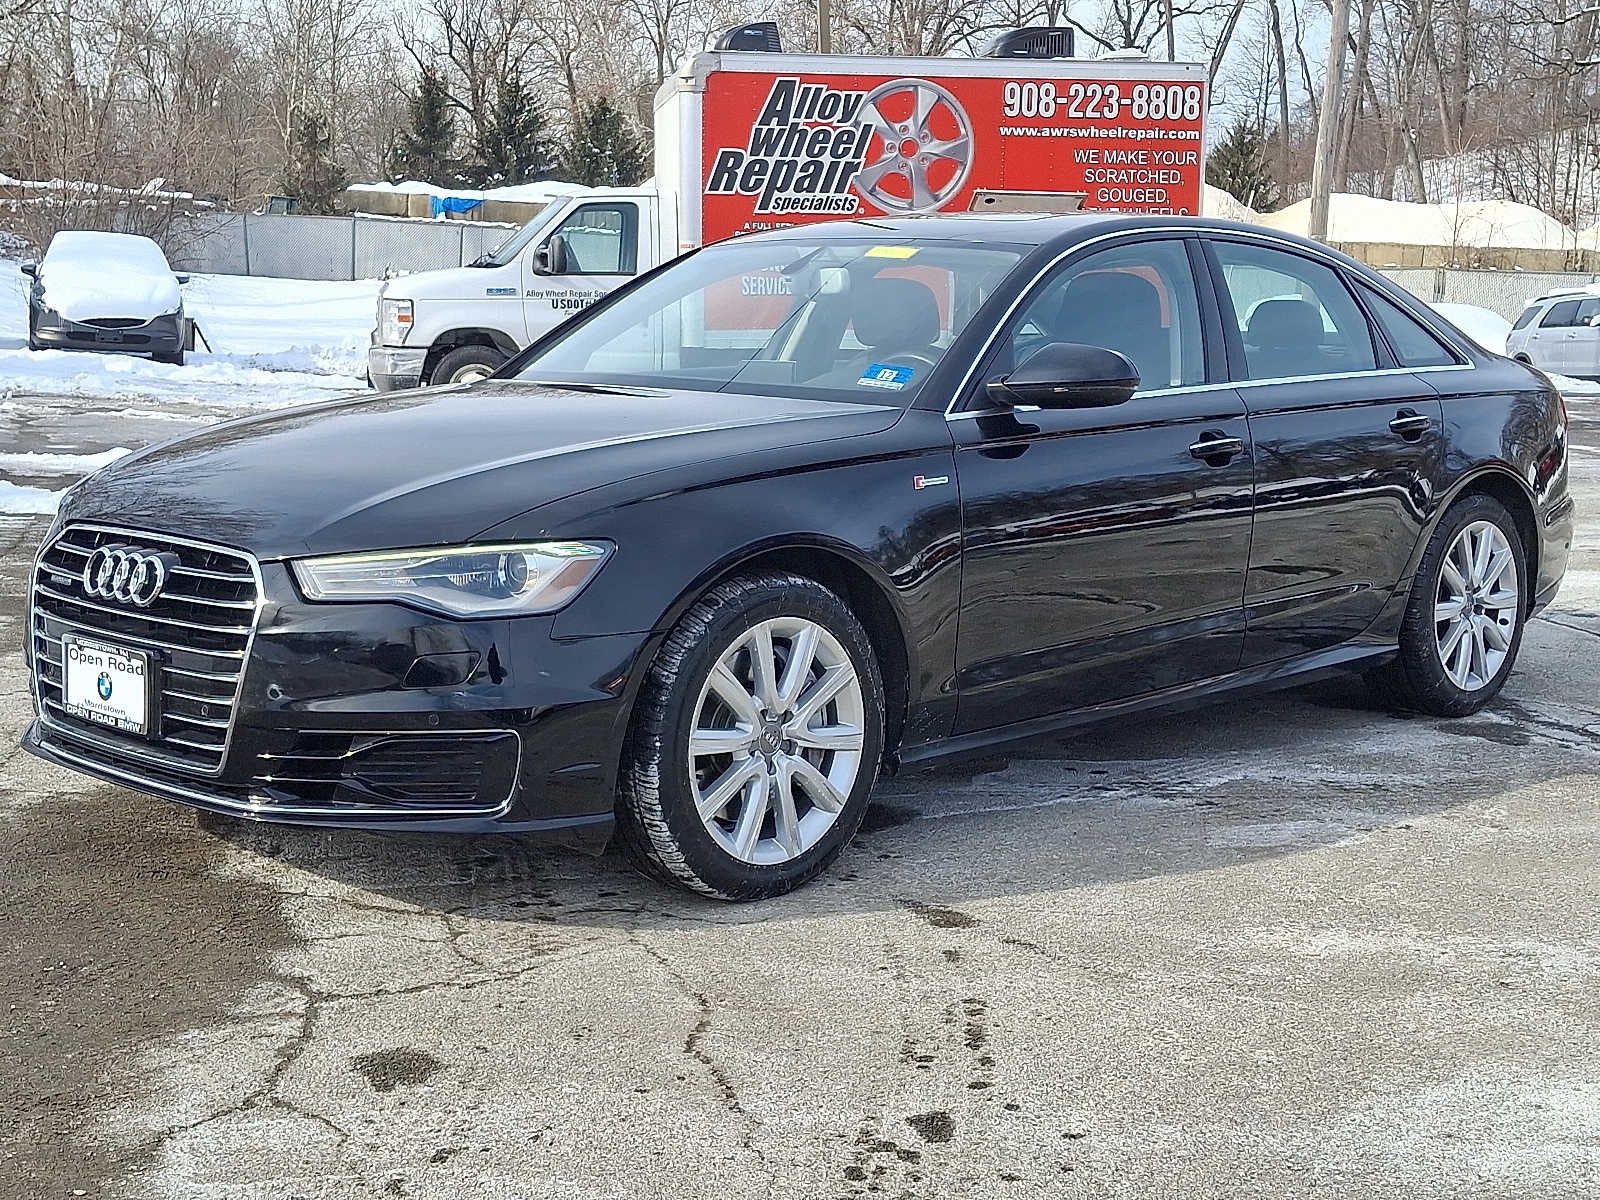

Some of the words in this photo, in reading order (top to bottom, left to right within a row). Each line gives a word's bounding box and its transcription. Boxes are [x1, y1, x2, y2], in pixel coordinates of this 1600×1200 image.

[756, 77, 868, 126] Alloy
[1003, 81, 1201, 120] 908-223-8808
[748, 122, 874, 160] wheel
[1000, 126, 1200, 141] www.awrswheelrepair.com
[1073, 149, 1100, 164] WE
[1103, 150, 1148, 165] MAKE
[1152, 151, 1198, 165] YOUR
[706, 148, 864, 213] Repair
[1084, 168, 1185, 185] SCRATCHED,
[771, 195, 857, 213] specialists
[1097, 188, 1171, 204] GOUGED,
[752, 222, 771, 230] FULL
[526, 289, 544, 299] Alloy
[545, 289, 567, 298] Wheel
[569, 290, 592, 299] Repair
[878, 370, 894, 380] 12
[70, 647, 103, 667] Open
[108, 656, 145, 676] Road
[66, 703, 90, 718] OPEN
[90, 711, 116, 726] ROAD
[117, 718, 141, 732] BMW
